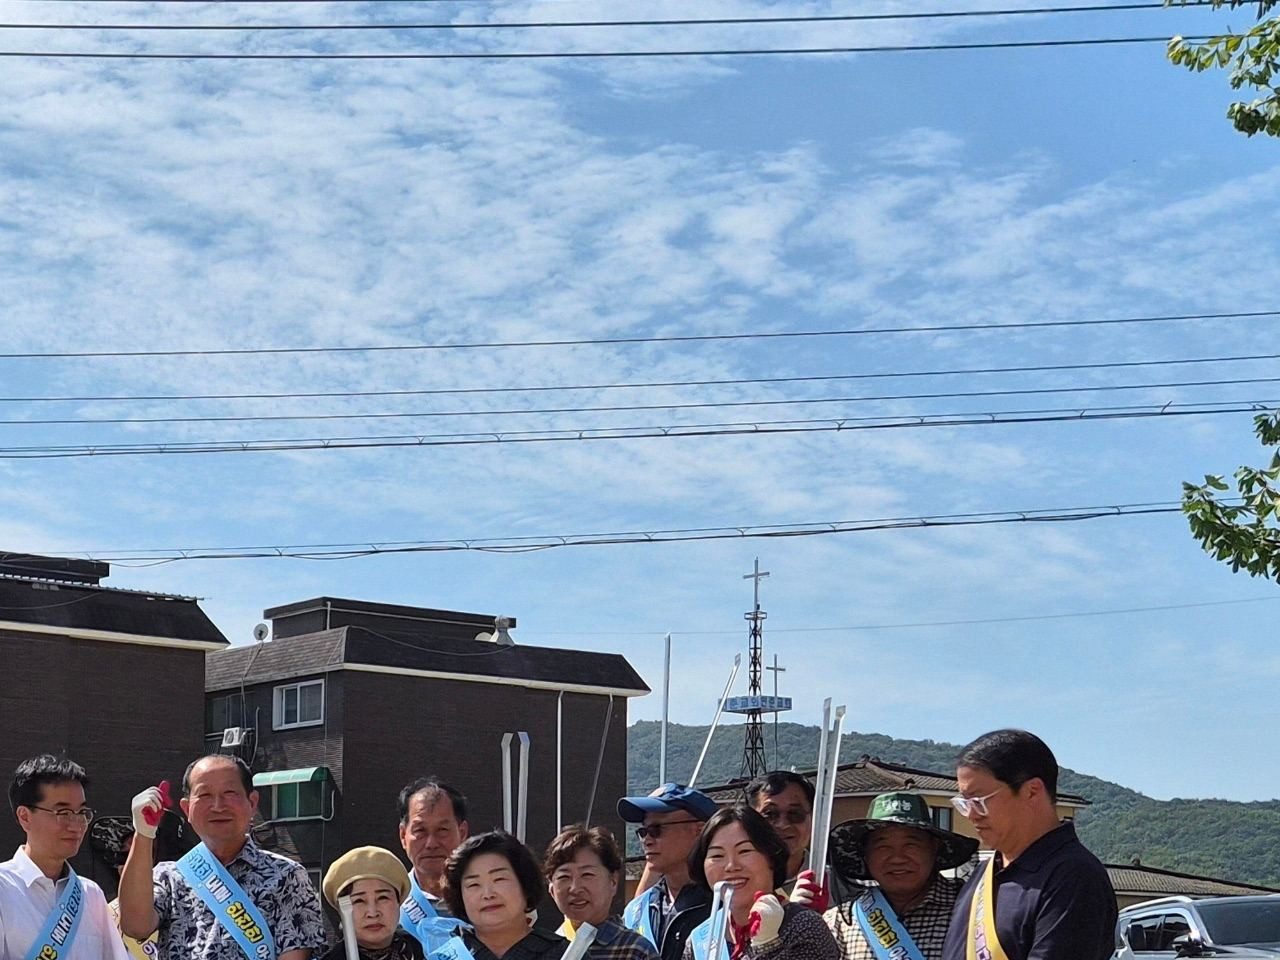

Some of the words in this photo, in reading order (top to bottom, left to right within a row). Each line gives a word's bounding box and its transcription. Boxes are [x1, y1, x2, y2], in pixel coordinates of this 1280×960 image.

[51, 914, 75, 947] 도로
[205, 875, 233, 903] 도로
[225, 900, 263, 943] 안전한
